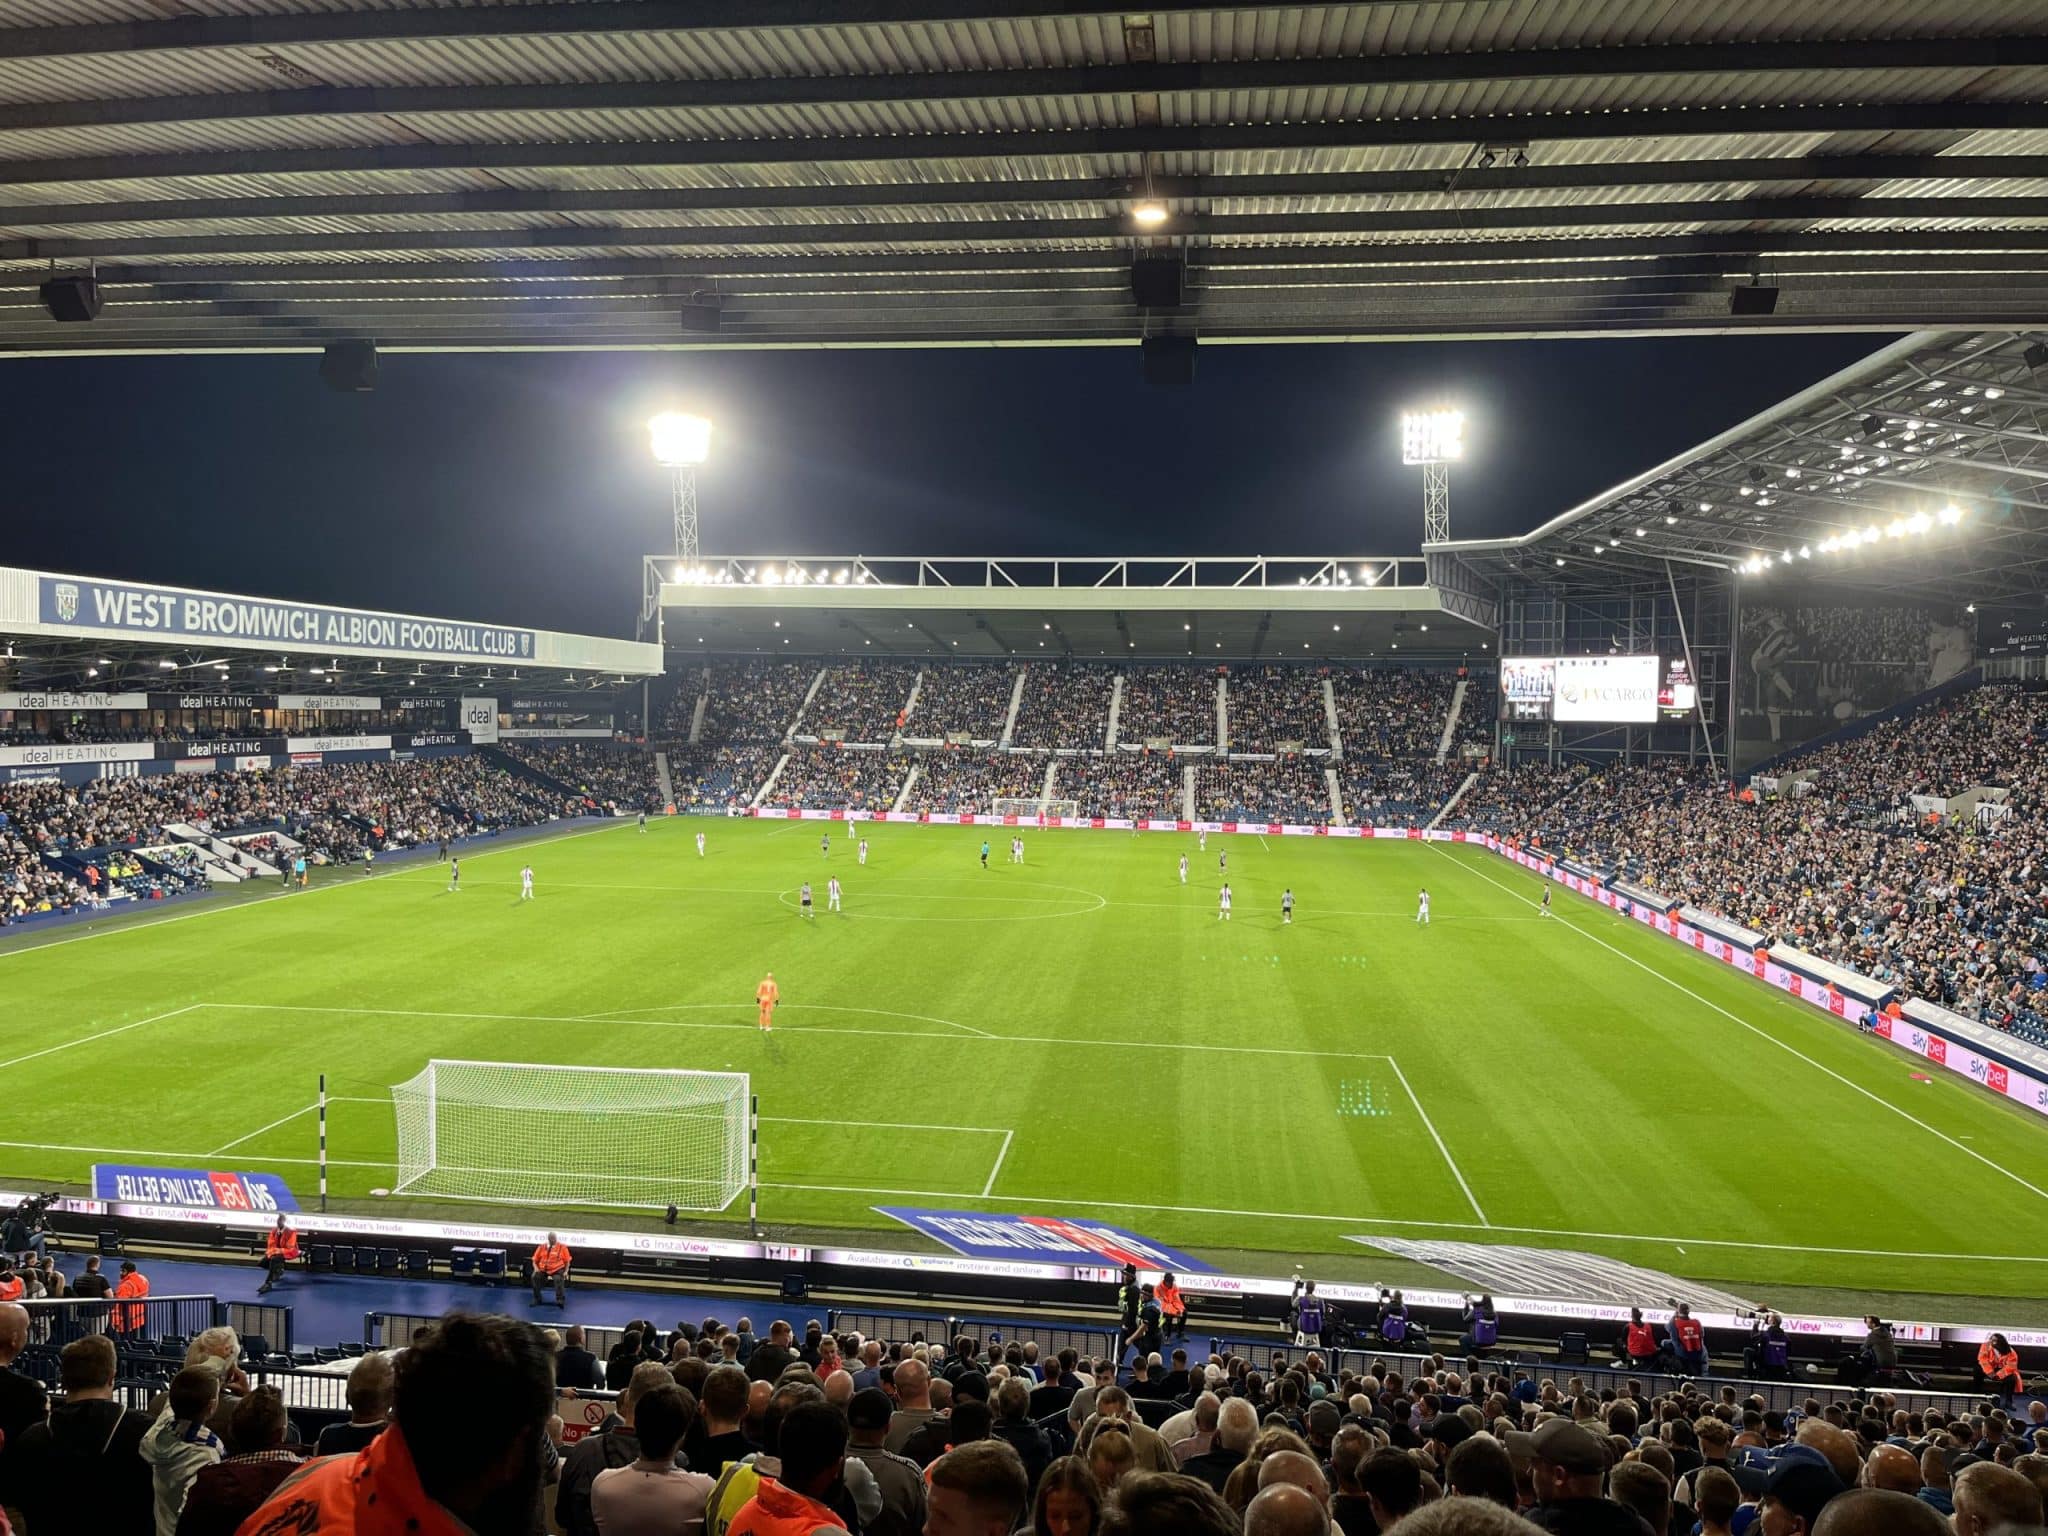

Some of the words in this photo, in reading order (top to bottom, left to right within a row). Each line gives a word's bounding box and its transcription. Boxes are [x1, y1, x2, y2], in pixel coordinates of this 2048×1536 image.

[94, 588, 176, 629] WEST
[184, 599, 319, 641] BROMWICH
[325, 614, 395, 646] ALBION
[401, 623, 479, 653] FOOTBALL
[482, 631, 516, 654] CLUB
[19, 694, 48, 708] ideal
[51, 695, 113, 706] HEATING
[180, 695, 203, 708] ideal
[205, 696, 253, 707] HEATING
[304, 697, 320, 708] ideal
[324, 699, 361, 708] HEATING
[400, 698, 415, 708] ideal
[415, 699, 446, 708] HEATING
[532, 700, 569, 708] HEATING
[467, 705, 492, 724] ideal
[314, 739, 332, 750] ideal
[333, 738, 370, 748] HEATING
[411, 736, 426, 746] ideal
[427, 735, 456, 745] HEATING
[23, 748, 52, 763] ideal
[55, 747, 118, 760] HEATING
[188, 742, 212, 757] ideal
[213, 742, 261, 754] HEATING
[1818, 988, 1829, 1008] sky
[1831, 992, 1843, 1013] bet
[1912, 1032, 1928, 1052] sky
[1928, 1038, 1946, 1060] bet
[1970, 1058, 1988, 1082] sky
[1988, 1067, 2008, 1090] bet
[2038, 1088, 2048, 1106] sk
[116, 1174, 160, 1202] BETTER
[160, 1176, 215, 1207] BETTING
[242, 1176, 278, 1211] sky
[215, 1182, 249, 1210] bet
[139, 1205, 154, 1217] LG
[157, 1205, 209, 1221] InstaView
[342, 1220, 374, 1231] What's
[376, 1222, 403, 1232] Inside
[442, 1226, 480, 1237] Without
[483, 1228, 514, 1241] letting
[515, 1233, 533, 1242] any
[633, 1238, 650, 1249] LG
[654, 1239, 709, 1252] InstaView
[847, 1253, 889, 1265] Available
[892, 1256, 901, 1265] at
[956, 1262, 990, 1272] instore
[992, 1264, 1011, 1273] and
[1012, 1265, 1043, 1276] online
[1181, 1275, 1241, 1290] InstaView
[1314, 1286, 1340, 1298] nock
[1437, 1295, 1466, 1305] Insid
[1513, 1300, 1558, 1313] Without
[1561, 1303, 1597, 1317] letting
[1600, 1309, 1619, 1319] any
[1647, 1311, 1661, 1321] air
[1733, 1317, 1752, 1327] LG
[2035, 1336, 2048, 1345] at
[563, 1427, 578, 1438] No
